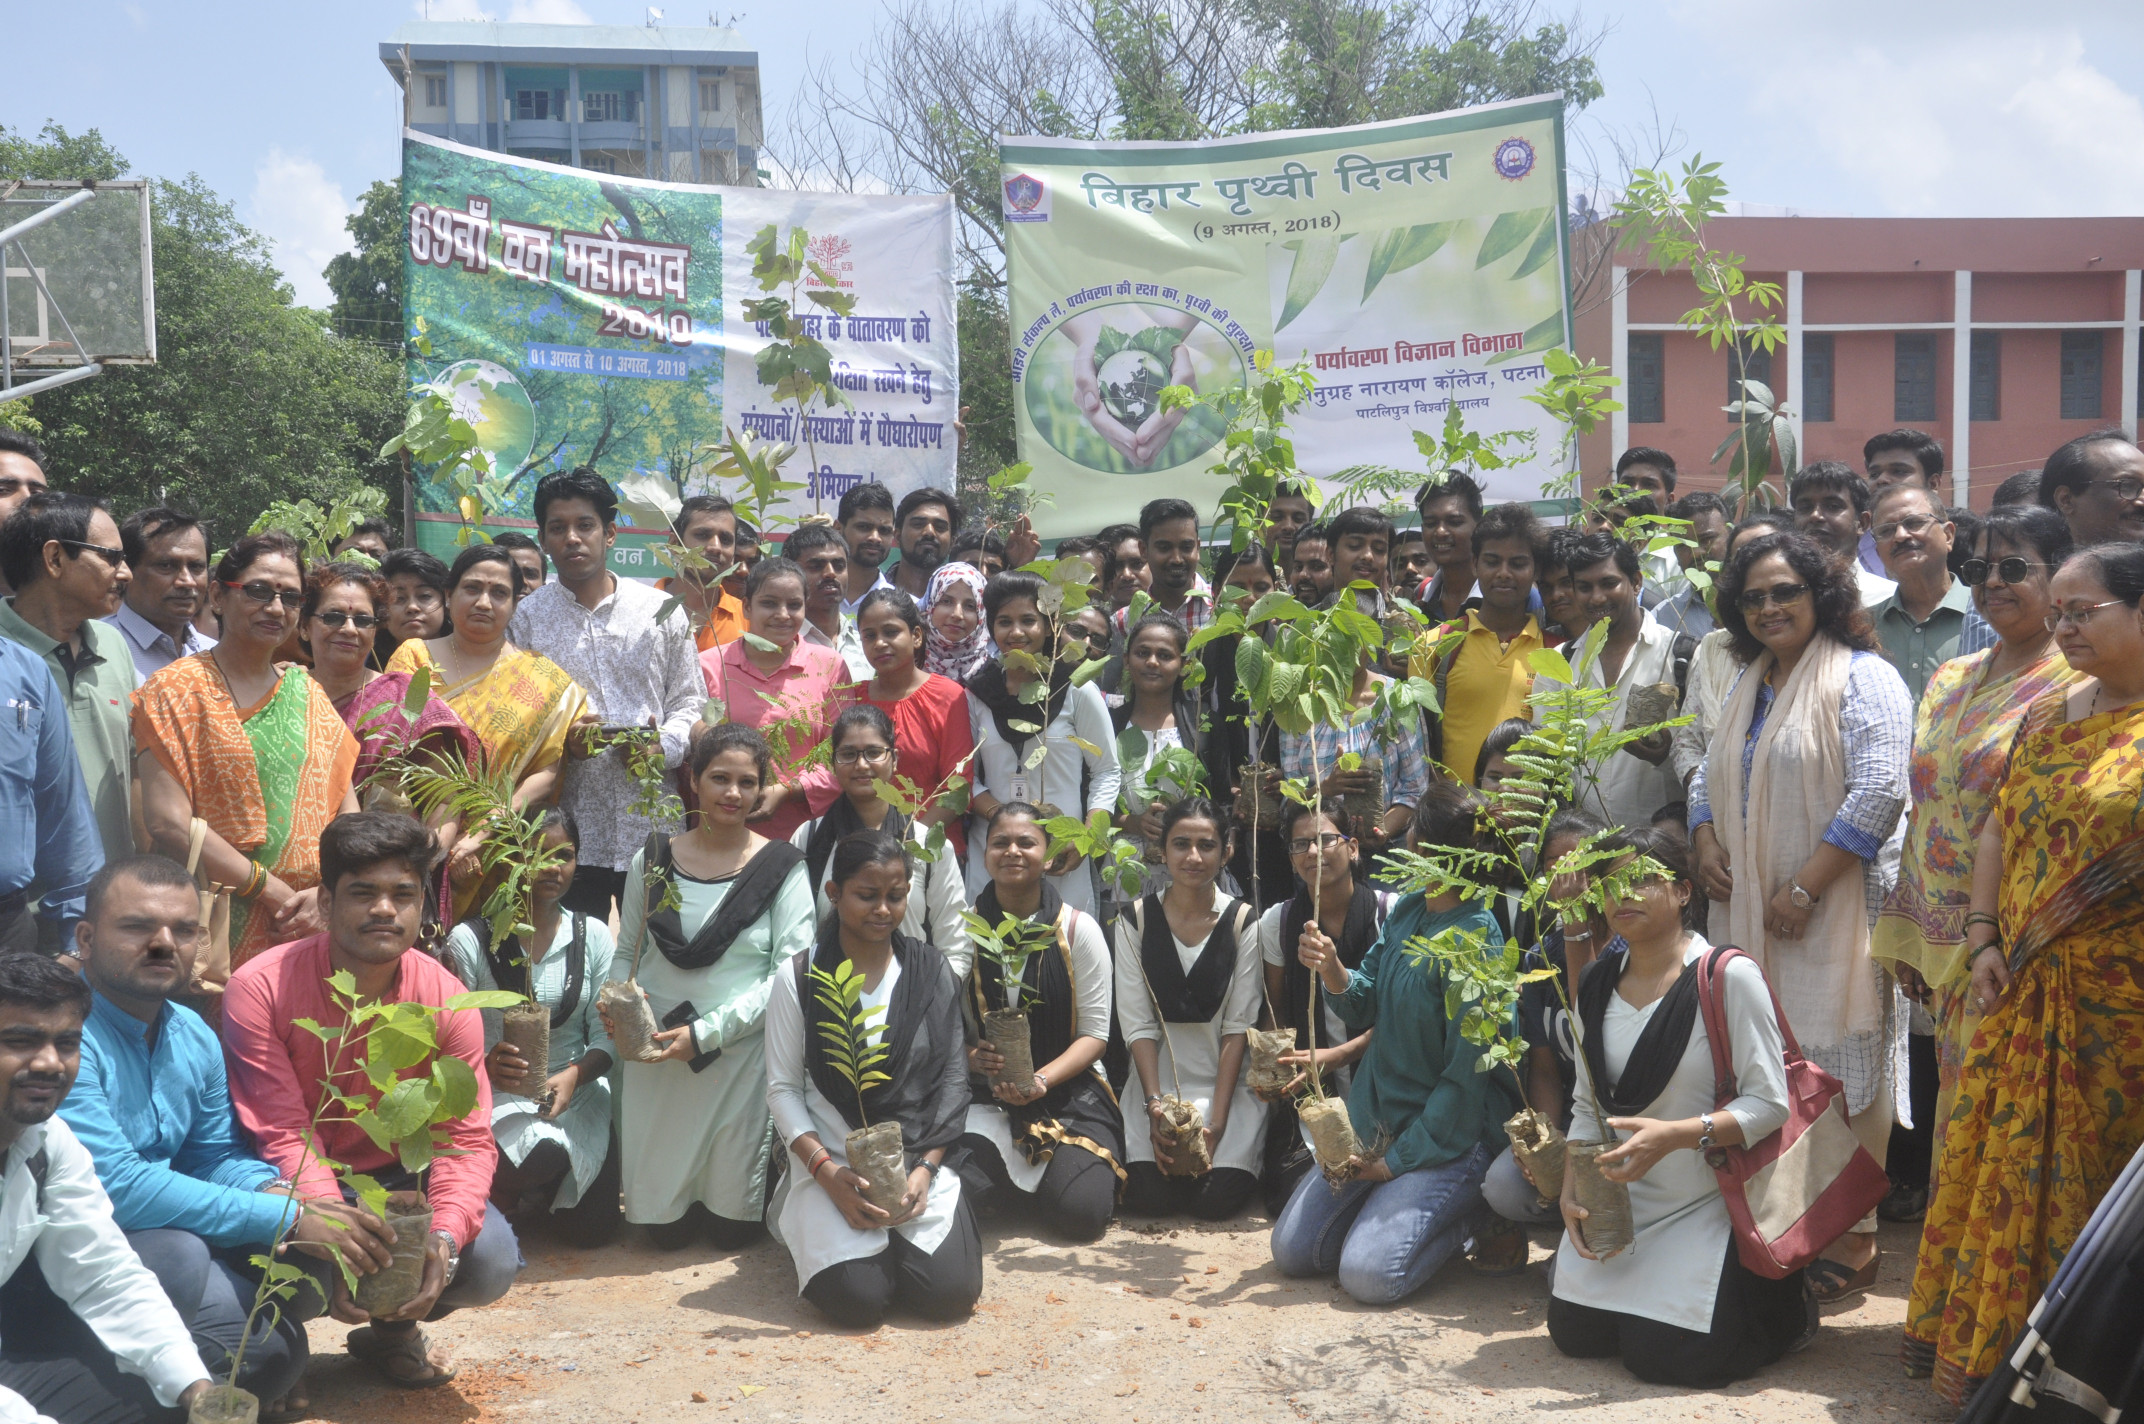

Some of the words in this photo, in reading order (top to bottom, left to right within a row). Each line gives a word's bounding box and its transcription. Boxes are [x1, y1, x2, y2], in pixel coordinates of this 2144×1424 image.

[1080, 172, 1200, 214] बिहार
[1214, 162, 1318, 215] पृथ्वी
[1334, 153, 1452, 192] दिवस
[1193, 221, 1214, 242] (9
[1222, 222, 1277, 237] अगस्त,
[1285, 210, 1341, 232] 2018)
[564, 223, 689, 299] महोत्सव
[794, 314, 822, 341] हर
[827, 309, 843, 341] के
[846, 315, 906, 342] वातावरण
[911, 310, 931, 343] को
[1066, 285, 1113, 308] पर्यावरण
[1116, 280, 1131, 295] की
[1136, 283, 1159, 297] रक्षा
[1185, 293, 1212, 313] पृथ्वी
[1211, 307, 1229, 323] की
[1225, 320, 1255, 353] सुरक्षा
[531, 349, 546, 365] 01
[550, 351, 581, 368] अगस्त
[584, 349, 594, 369] से
[599, 355, 613, 371] 10
[617, 356, 651, 377] अगस्त,
[657, 359, 686, 377] 2018
[1315, 346, 1388, 370] पर्यावरण
[1395, 340, 1455, 363] विज्ञान
[1462, 332, 1523, 356] विभाग
[911, 362, 932, 404] हेतु
[1359, 377, 1426, 397] नारायण
[1434, 369, 1495, 391] कॉलेज,
[1501, 365, 1545, 382] पटना
[1356, 404, 1409, 420] पाटलिपुत्र
[1414, 397, 1490, 414] विश्विद्यालय
[859, 412, 874, 445] में
[877, 413, 943, 449] पौधारोपण
[613, 547, 646, 566] वन
